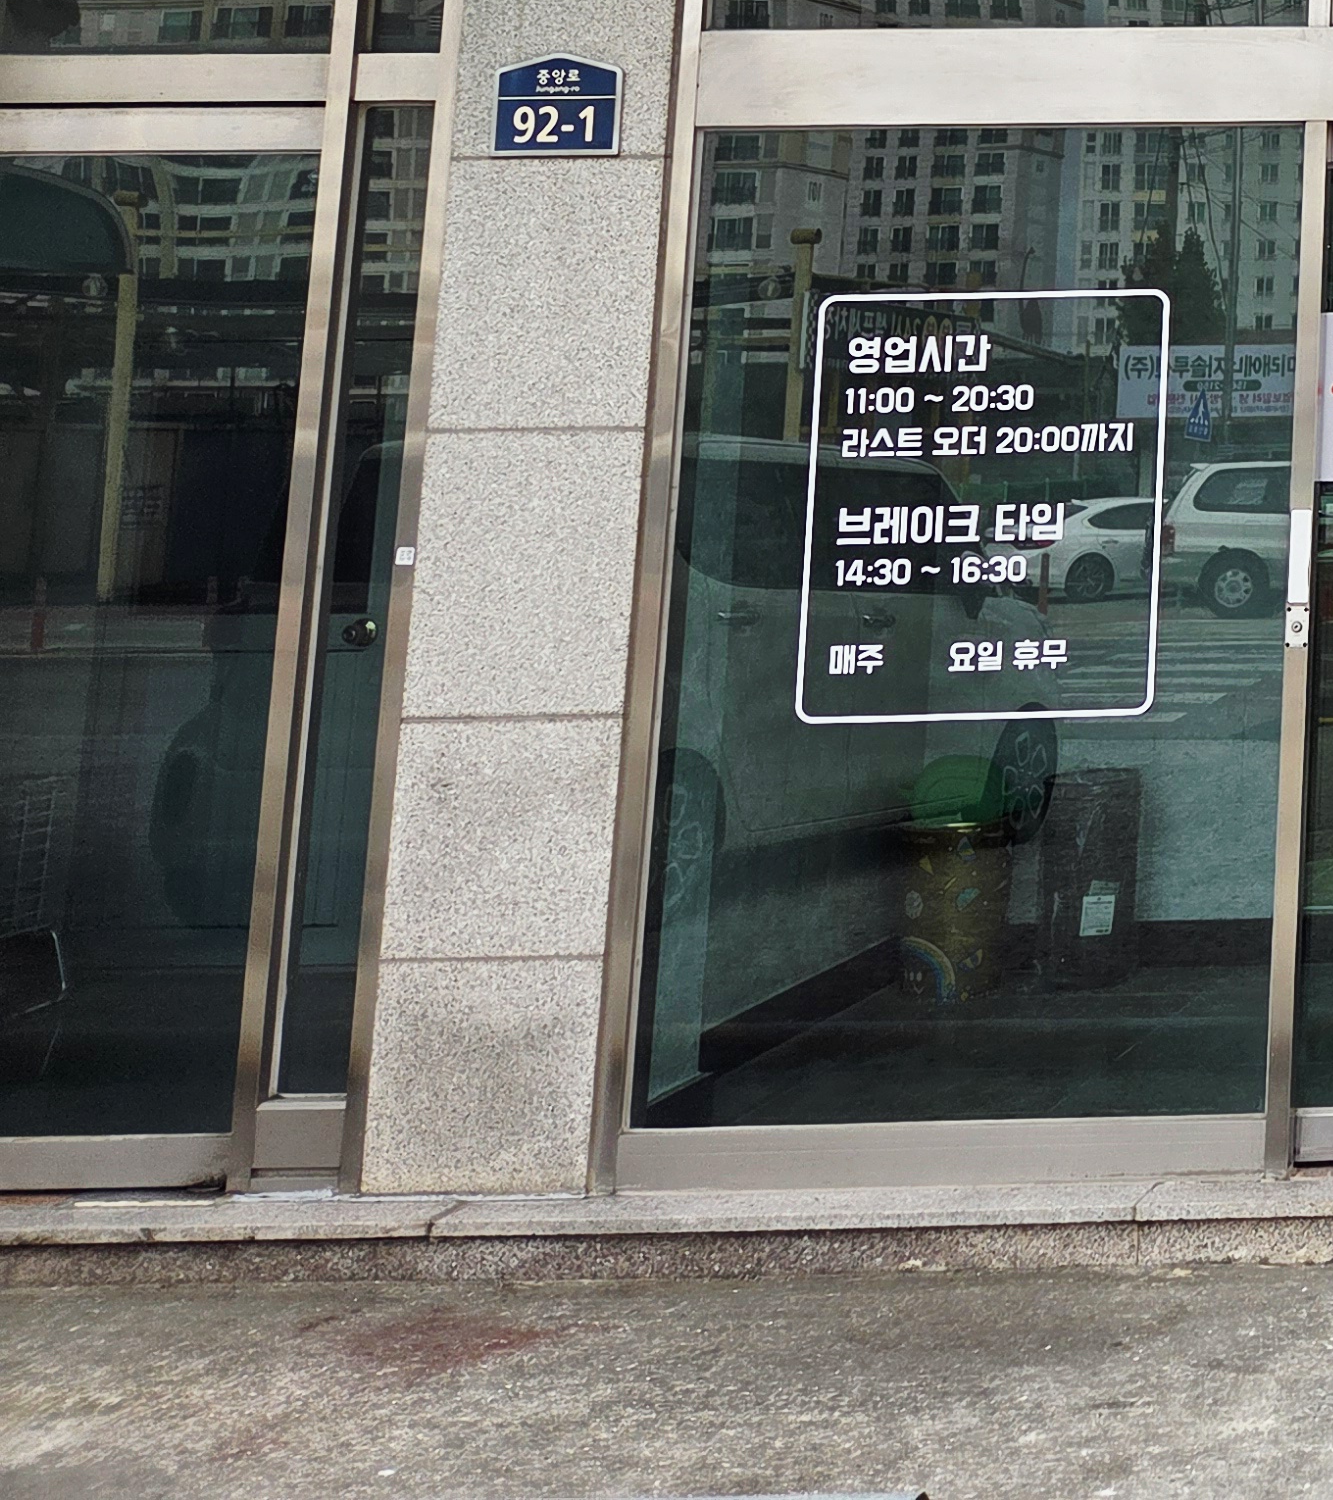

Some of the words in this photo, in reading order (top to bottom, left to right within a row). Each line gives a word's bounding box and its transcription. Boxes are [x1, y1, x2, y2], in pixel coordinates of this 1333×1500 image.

[537, 69, 581, 86] 중앙로
[513, 105, 595, 144] 92-1
[848, 334, 992, 374] 영업시간
[845, 386, 915, 415] 11:00
[951, 384, 1034, 412] 20:30
[841, 427, 923, 458] 라스트
[931, 425, 987, 456] 오더
[995, 422, 1134, 454] 20:00까지
[835, 504, 981, 546] 브레이크
[994, 502, 1065, 543] 타임
[835, 558, 912, 587] 14:30
[950, 556, 1028, 584] 16:30
[828, 644, 884, 675] 매주
[947, 640, 1003, 672] 요일
[1012, 638, 1068, 671] 휴무
